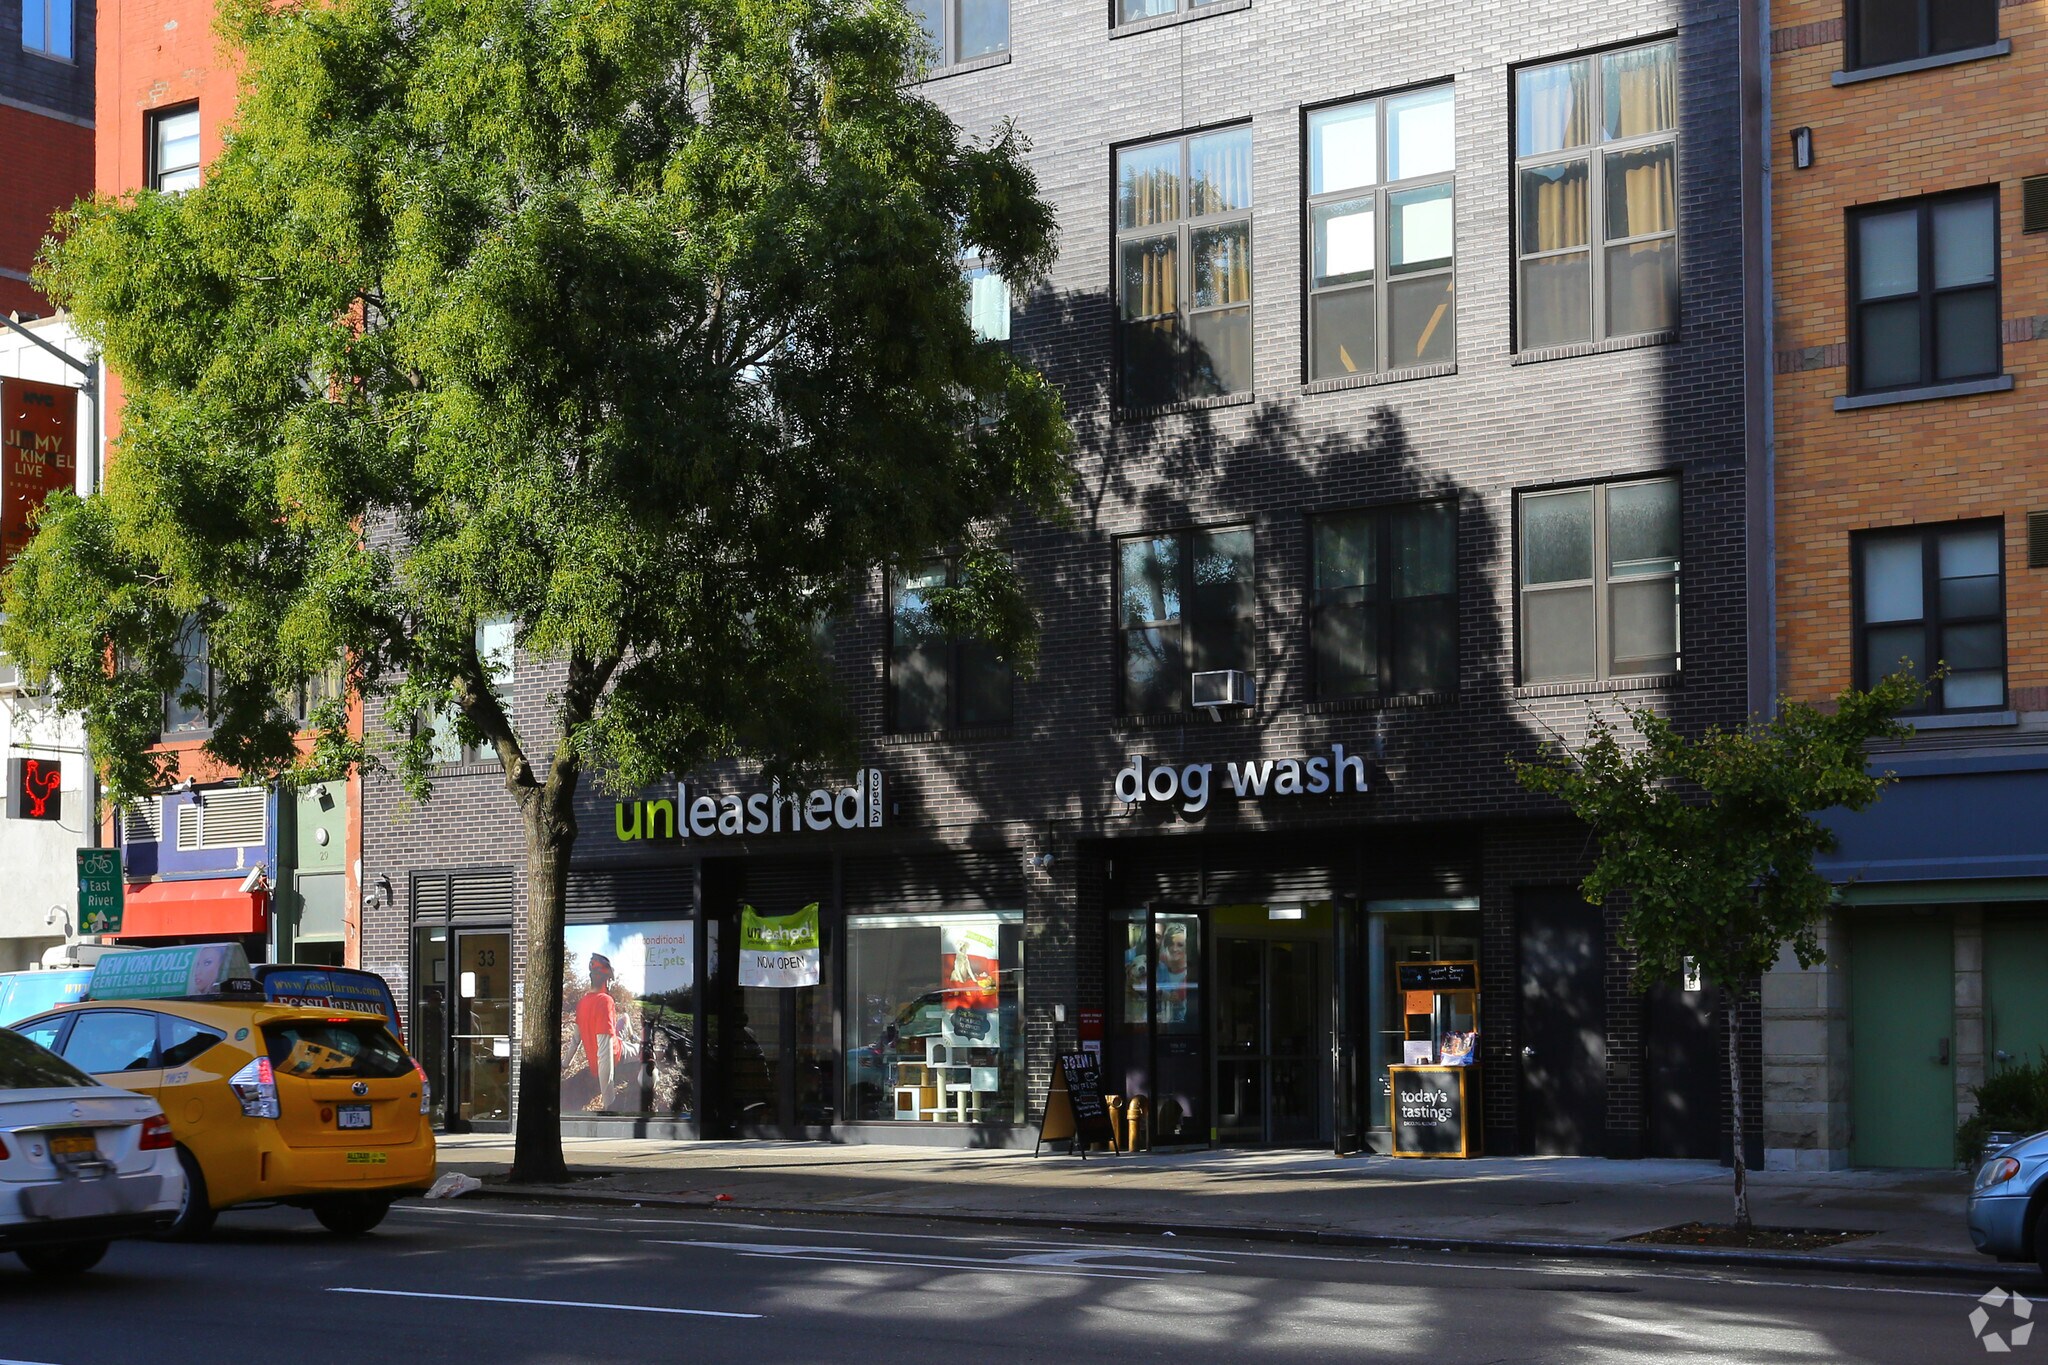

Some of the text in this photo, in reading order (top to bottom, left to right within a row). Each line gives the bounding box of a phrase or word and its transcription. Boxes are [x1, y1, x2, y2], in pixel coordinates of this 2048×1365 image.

[5, 429, 63, 452] JIMY
[20, 449, 75, 469] KIMEL
[15, 462, 43, 478] LIVE
[1115, 744, 1368, 812] dog wash
[615, 768, 865, 841] unleashed
[871, 772, 880, 823] by petco
[319, 851, 329, 861] 29
[90, 880, 111, 891] East
[88, 895, 114, 906] River
[96, 951, 193, 975] NEW YORK DOLLS
[478, 950, 495, 967] 33
[663, 955, 686, 969] pets
[757, 955, 805, 970] NOW OPEN
[93, 970, 188, 989] GENTLEMEN'S CLUB
[1401, 1089, 1448, 1107] today's
[1402, 1105, 1452, 1122] tastings
